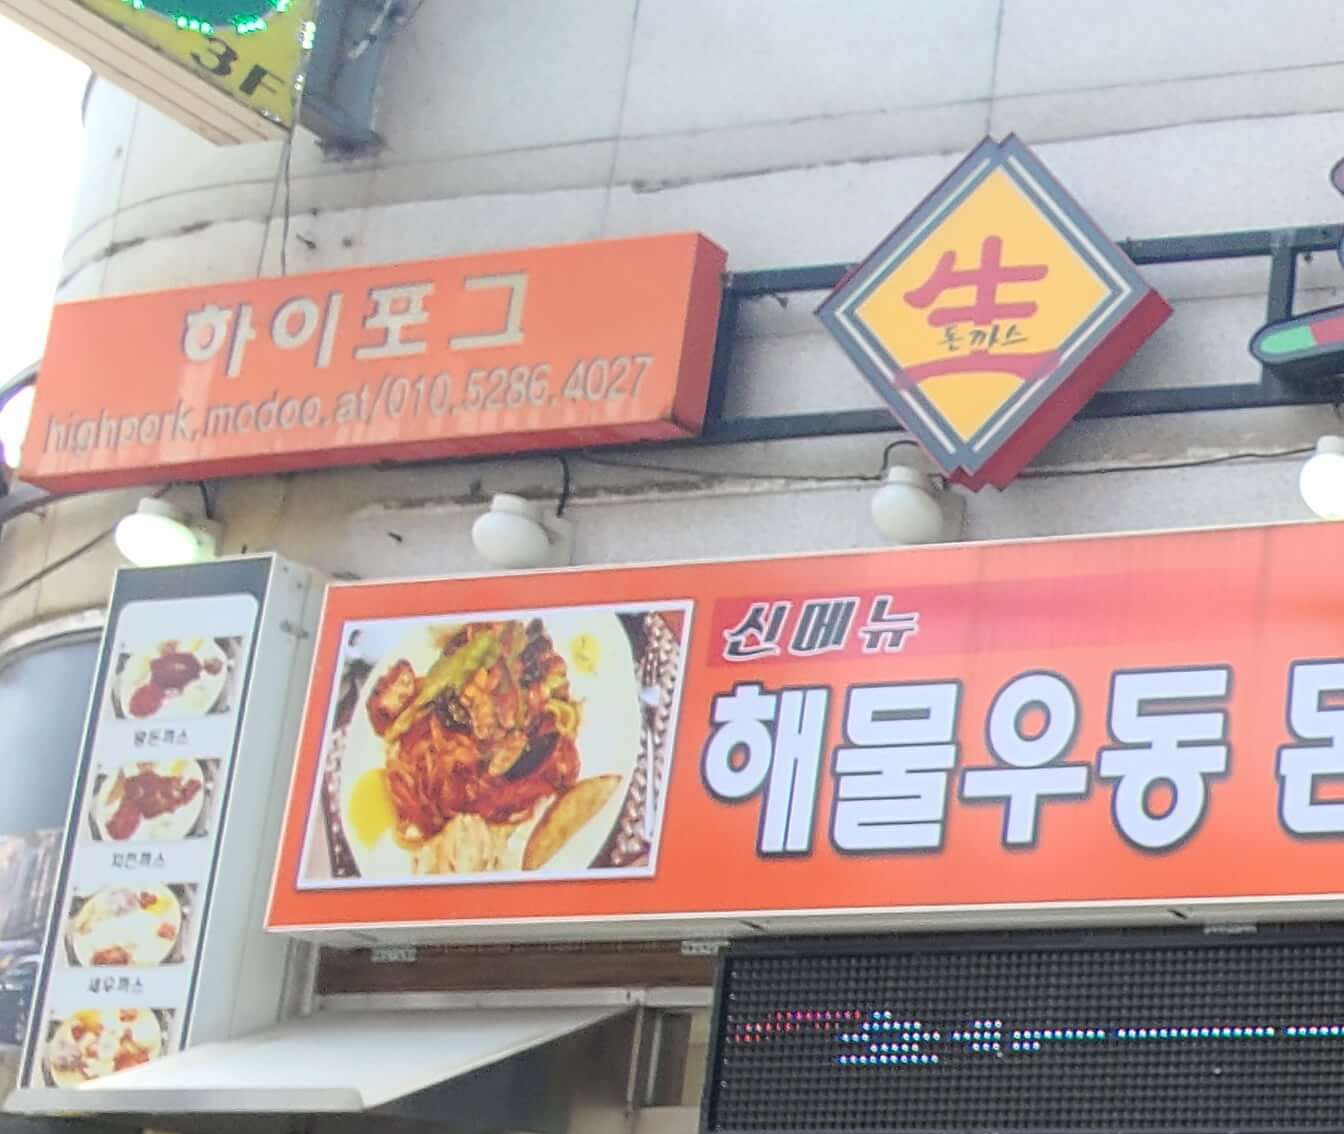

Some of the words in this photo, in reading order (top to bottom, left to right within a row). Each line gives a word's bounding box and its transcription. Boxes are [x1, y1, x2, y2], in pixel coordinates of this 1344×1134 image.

[191, 36, 286, 97] 3F
[181, 272, 530, 379] 하이포그
[897, 235, 1062, 388] 生
[938, 324, 1030, 352] 돈까스
[722, 594, 919, 661] 신메뉴
[700, 664, 1232, 858] 해물우동
